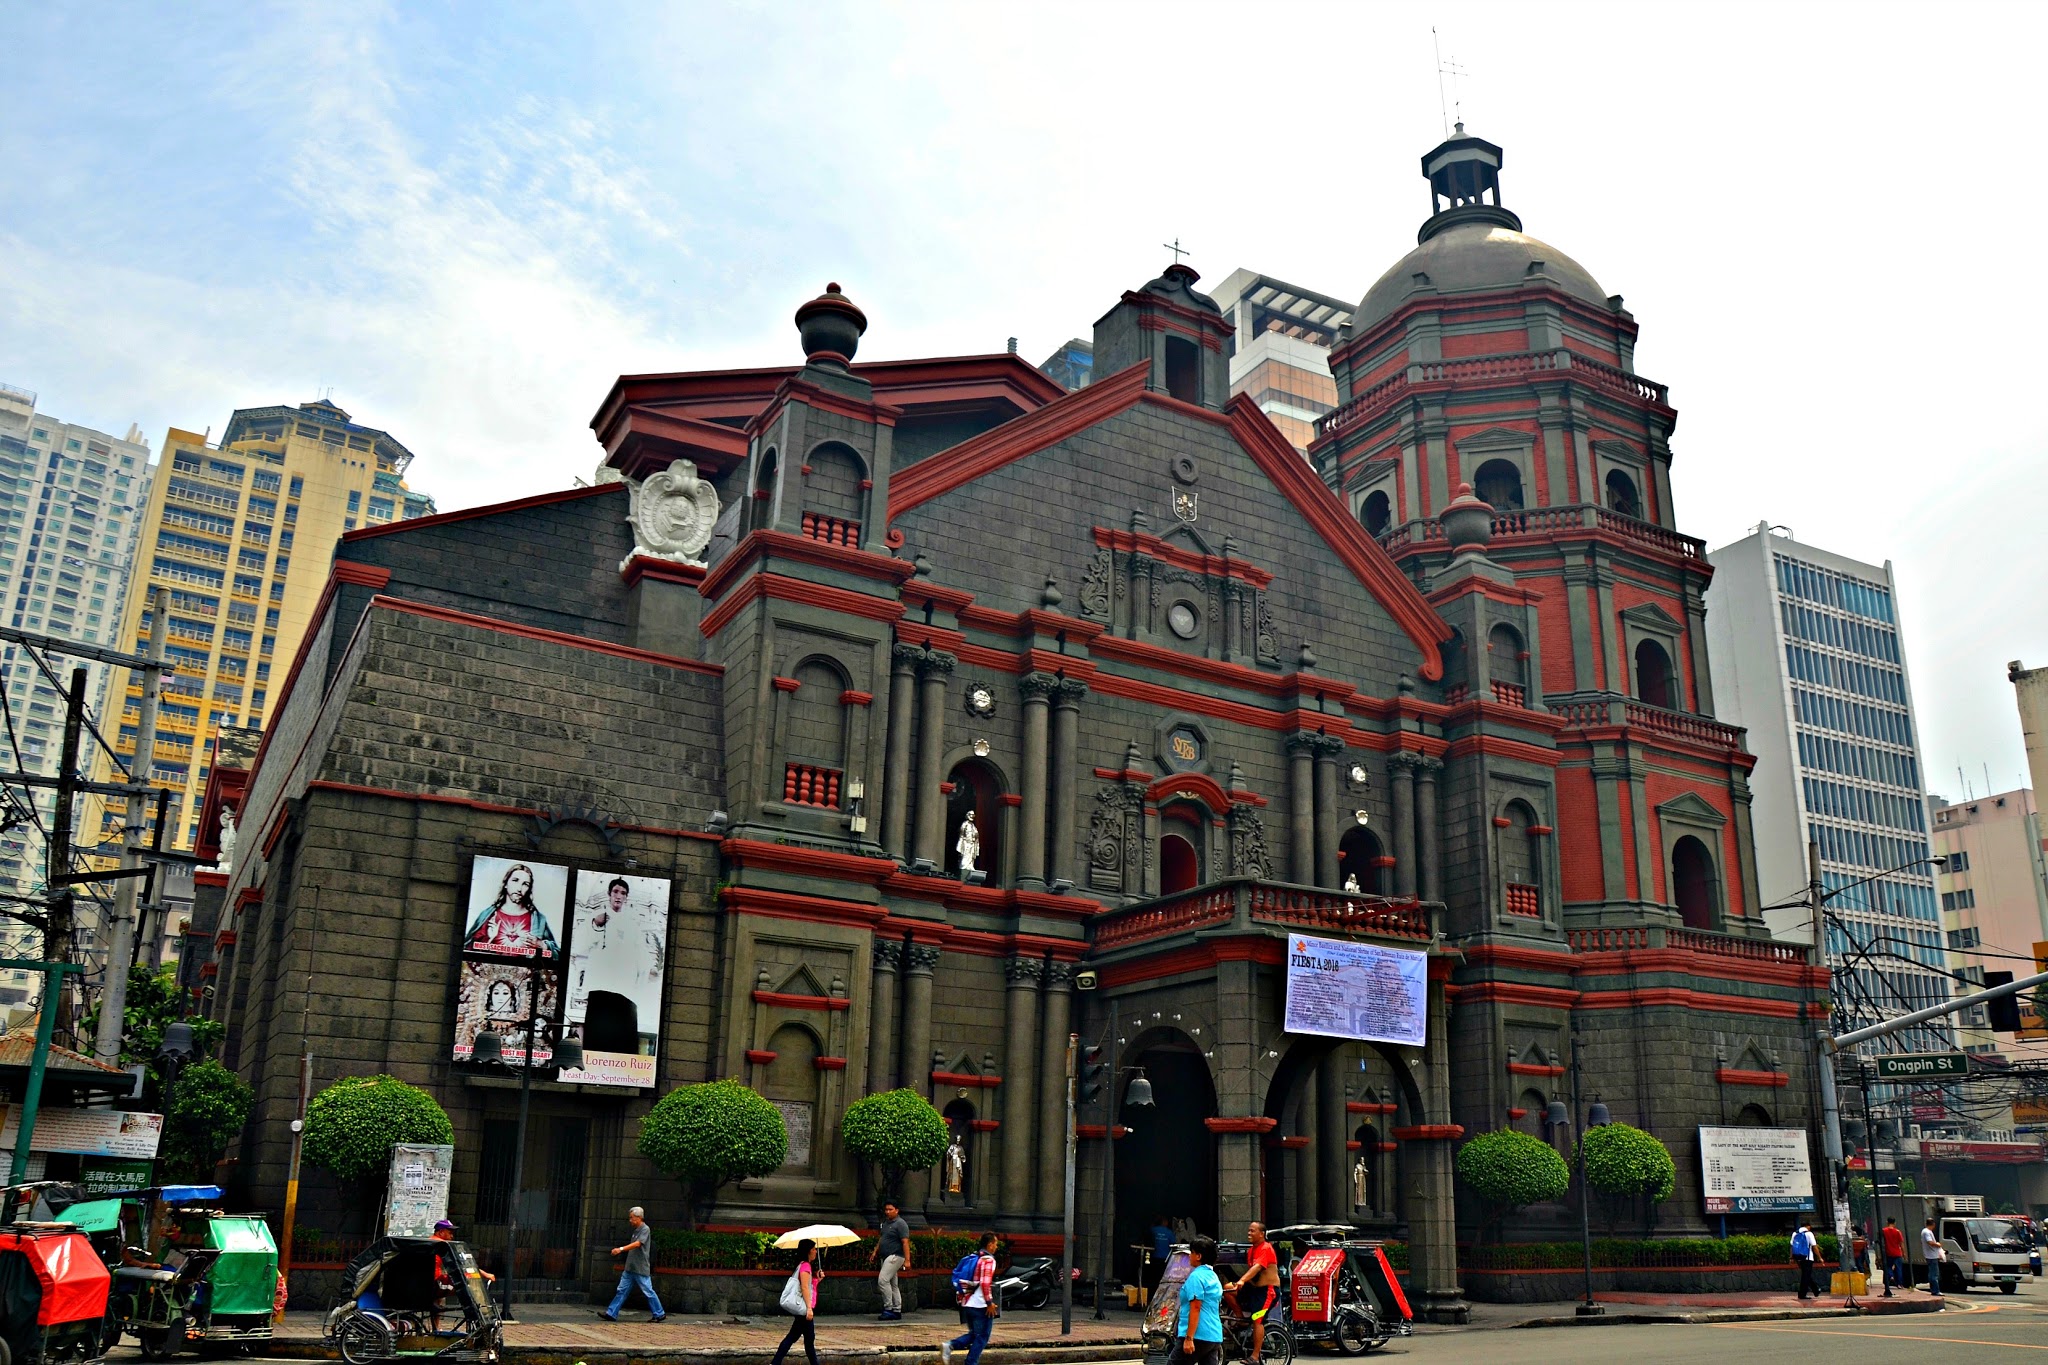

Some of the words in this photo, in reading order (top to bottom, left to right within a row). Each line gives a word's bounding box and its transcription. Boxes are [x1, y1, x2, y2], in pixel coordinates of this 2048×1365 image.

[473, 942, 490, 950] MOST
[511, 946, 528, 954] HEART
[1291, 954, 1322, 970] FIESTA
[585, 1054, 627, 1068] Lorenzo
[630, 1058, 652, 1070] Ruiz
[1887, 1059, 1934, 1073] Ongpin
[1937, 1057, 1953, 1069] St
[563, 1070, 582, 1079] Feast
[583, 1072, 600, 1080] Day:
[601, 1074, 639, 1084] September
